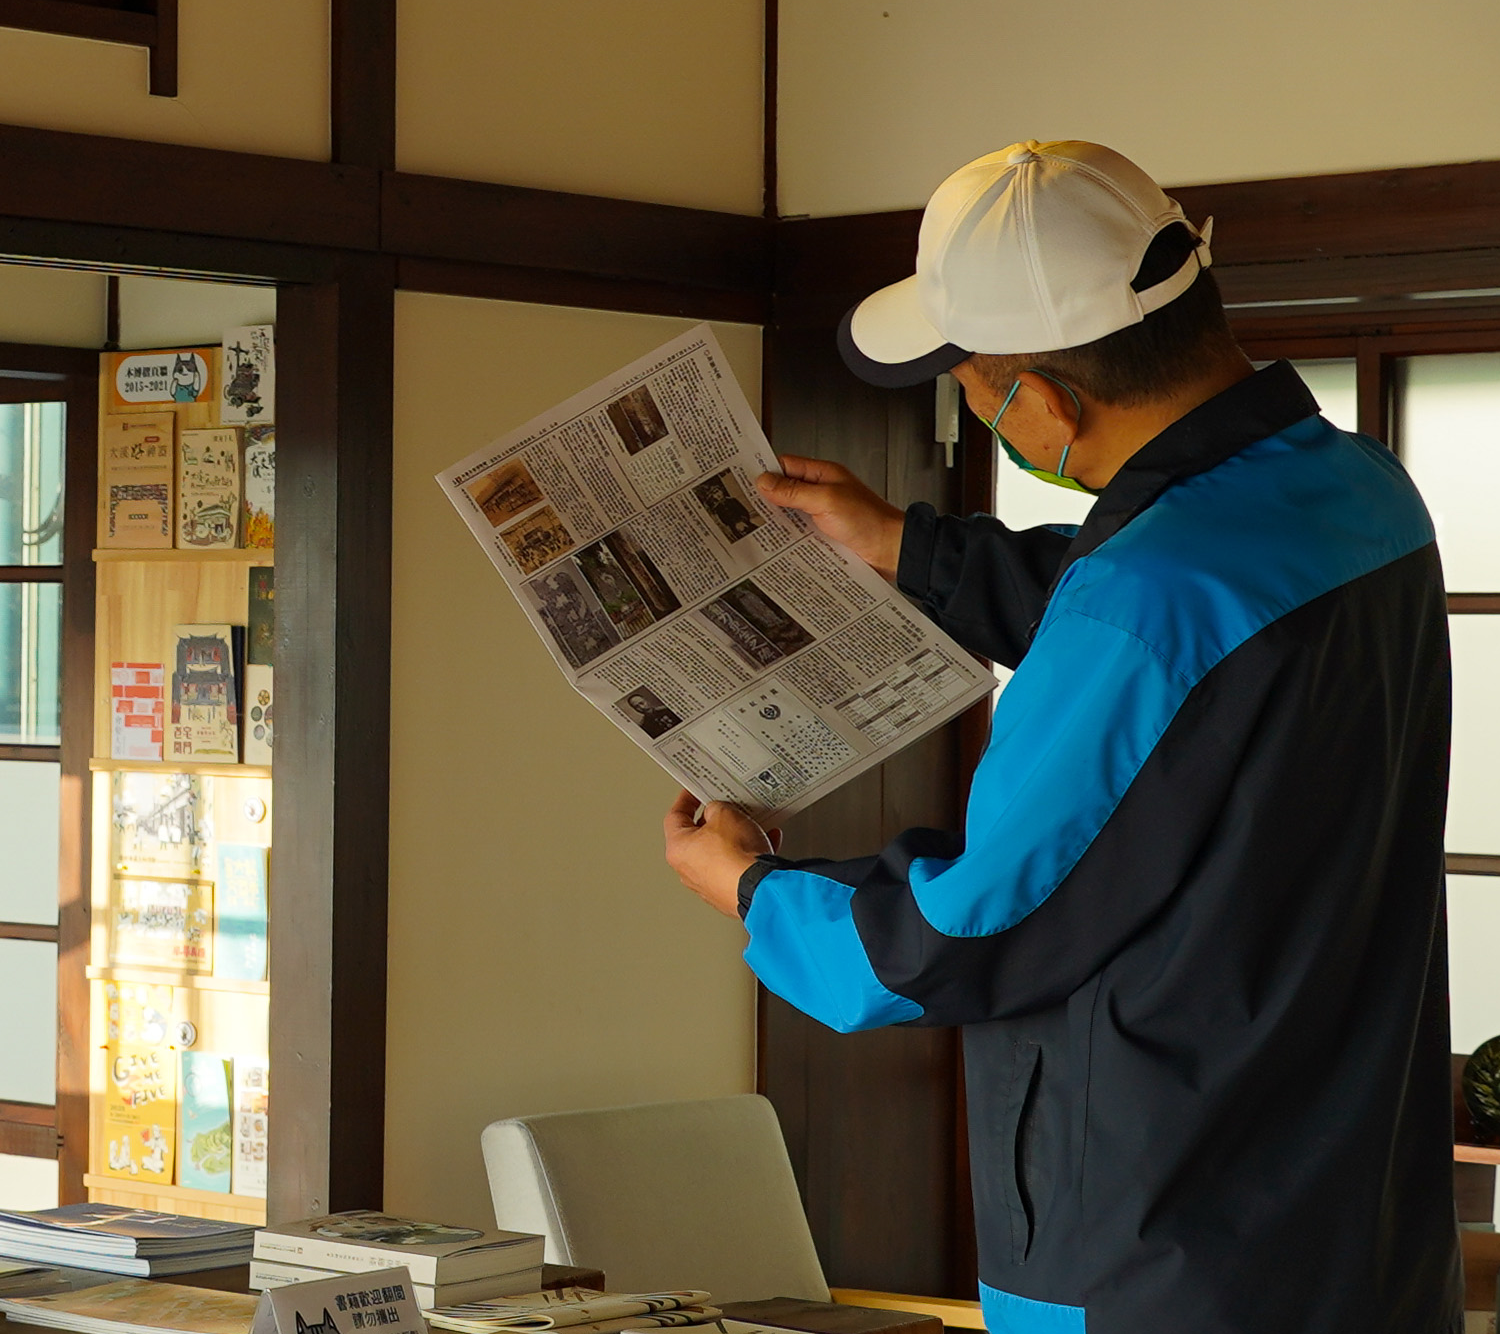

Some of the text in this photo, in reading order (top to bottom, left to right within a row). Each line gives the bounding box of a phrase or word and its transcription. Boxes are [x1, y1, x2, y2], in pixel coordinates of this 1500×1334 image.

[124, 379, 169, 394] 2015~2021
[112, 1050, 160, 1083] GIVE
[351, 1306, 401, 1330] 請勿攜出
